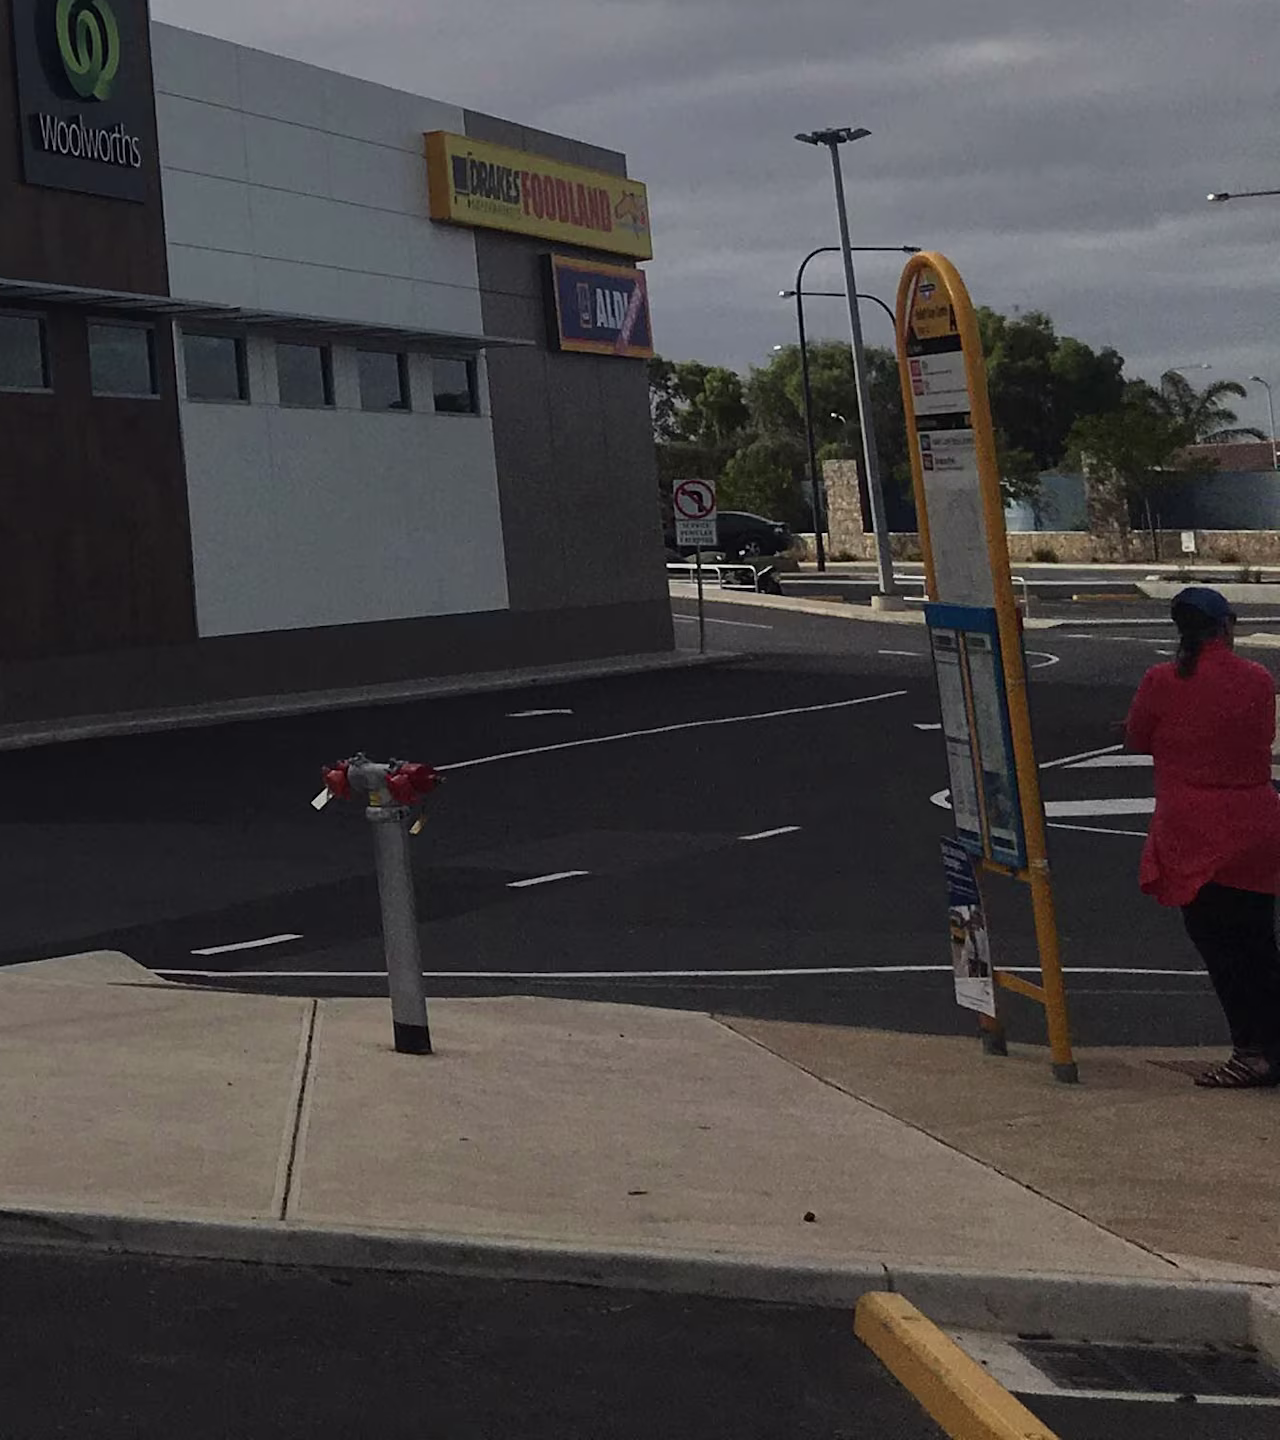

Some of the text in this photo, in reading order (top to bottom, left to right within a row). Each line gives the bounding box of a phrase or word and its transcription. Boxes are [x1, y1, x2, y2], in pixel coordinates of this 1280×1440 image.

[38, 112, 141, 168] Woolworths
[471, 160, 612, 232] DRAKES FOODLAND
